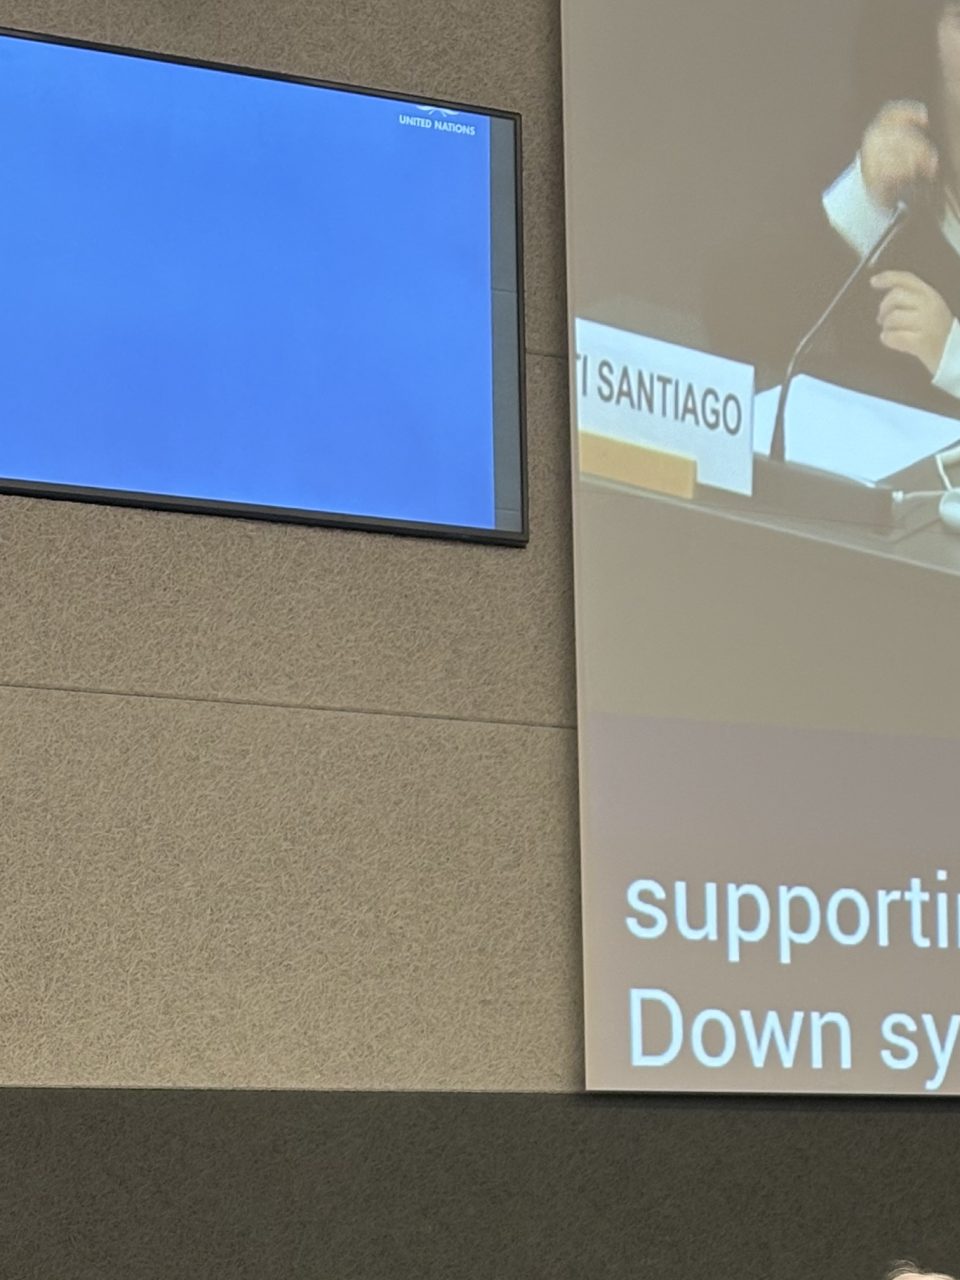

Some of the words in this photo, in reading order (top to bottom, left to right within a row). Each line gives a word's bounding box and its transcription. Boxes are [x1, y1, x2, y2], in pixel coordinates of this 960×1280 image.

[399, 115, 432, 128] UNITED
[435, 120, 476, 136] NATIONS
[597, 359, 742, 436] SANTIAGO
[629, 988, 852, 1069] Down
